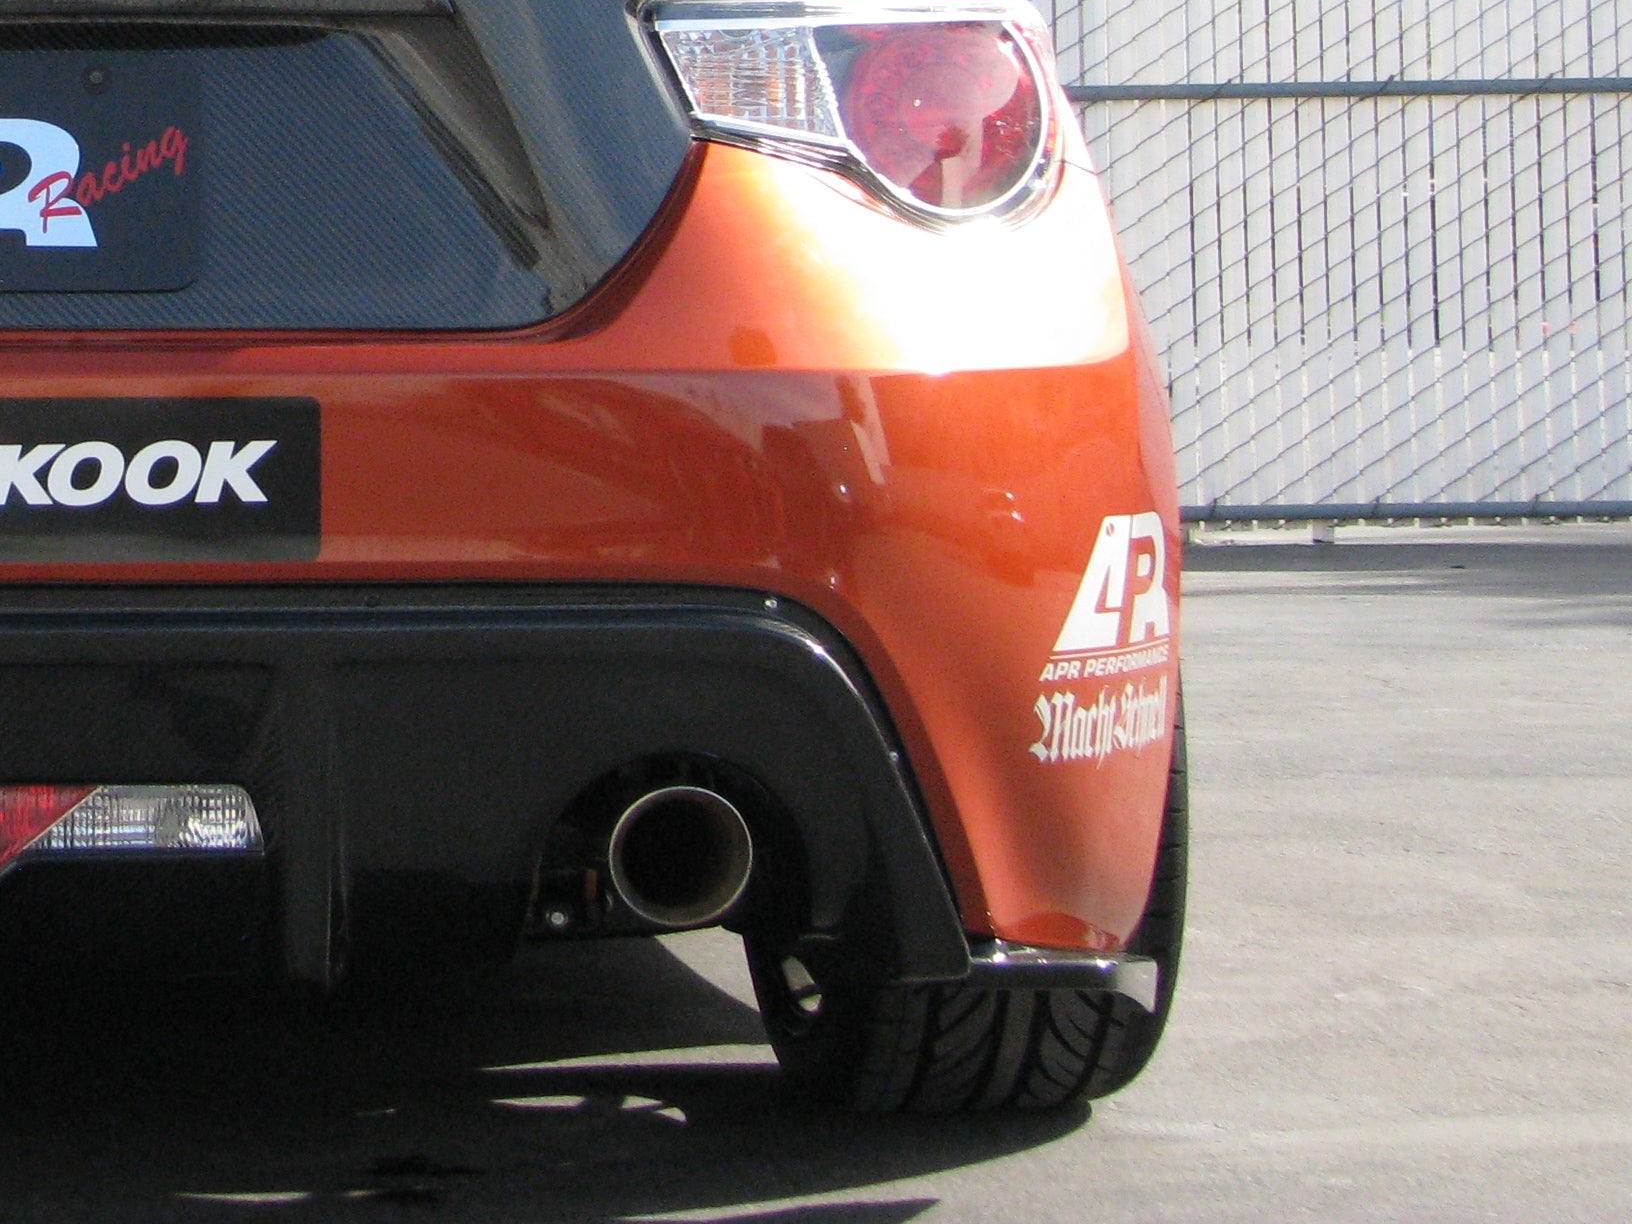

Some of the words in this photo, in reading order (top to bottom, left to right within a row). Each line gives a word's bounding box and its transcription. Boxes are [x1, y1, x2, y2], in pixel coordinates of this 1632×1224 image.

[27, 126, 189, 234] Racing
[1052, 511, 1171, 652] APR
[1039, 661, 1081, 682] APR
[1083, 644, 1169, 678] PERFORMANCE
